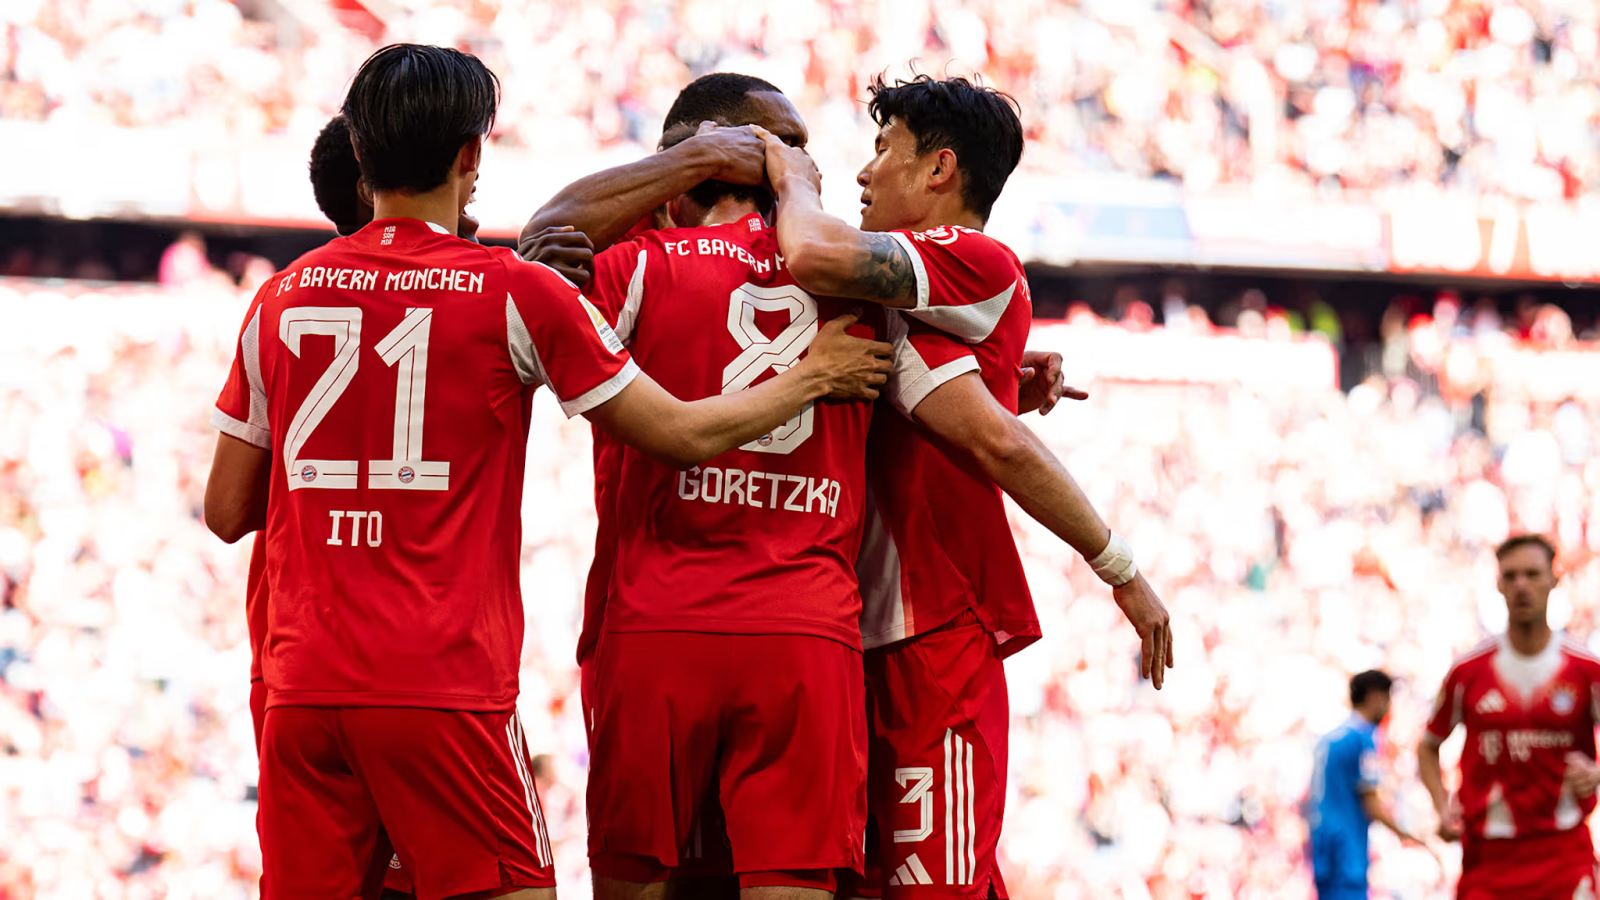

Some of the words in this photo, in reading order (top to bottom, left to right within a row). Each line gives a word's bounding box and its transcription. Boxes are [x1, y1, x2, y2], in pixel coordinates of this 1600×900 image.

[276, 272, 297, 297] FC
[299, 266, 379, 290] BAYERN
[384, 268, 485, 293] MÜNCHEN
[664, 240, 691, 256] FC
[697, 238, 770, 274] BAYERN
[721, 282, 818, 455] 8
[279, 306, 450, 491] 21
[678, 465, 841, 518] GORETZKA
[327, 510, 382, 547] ITO
[894, 767, 933, 843] 3
